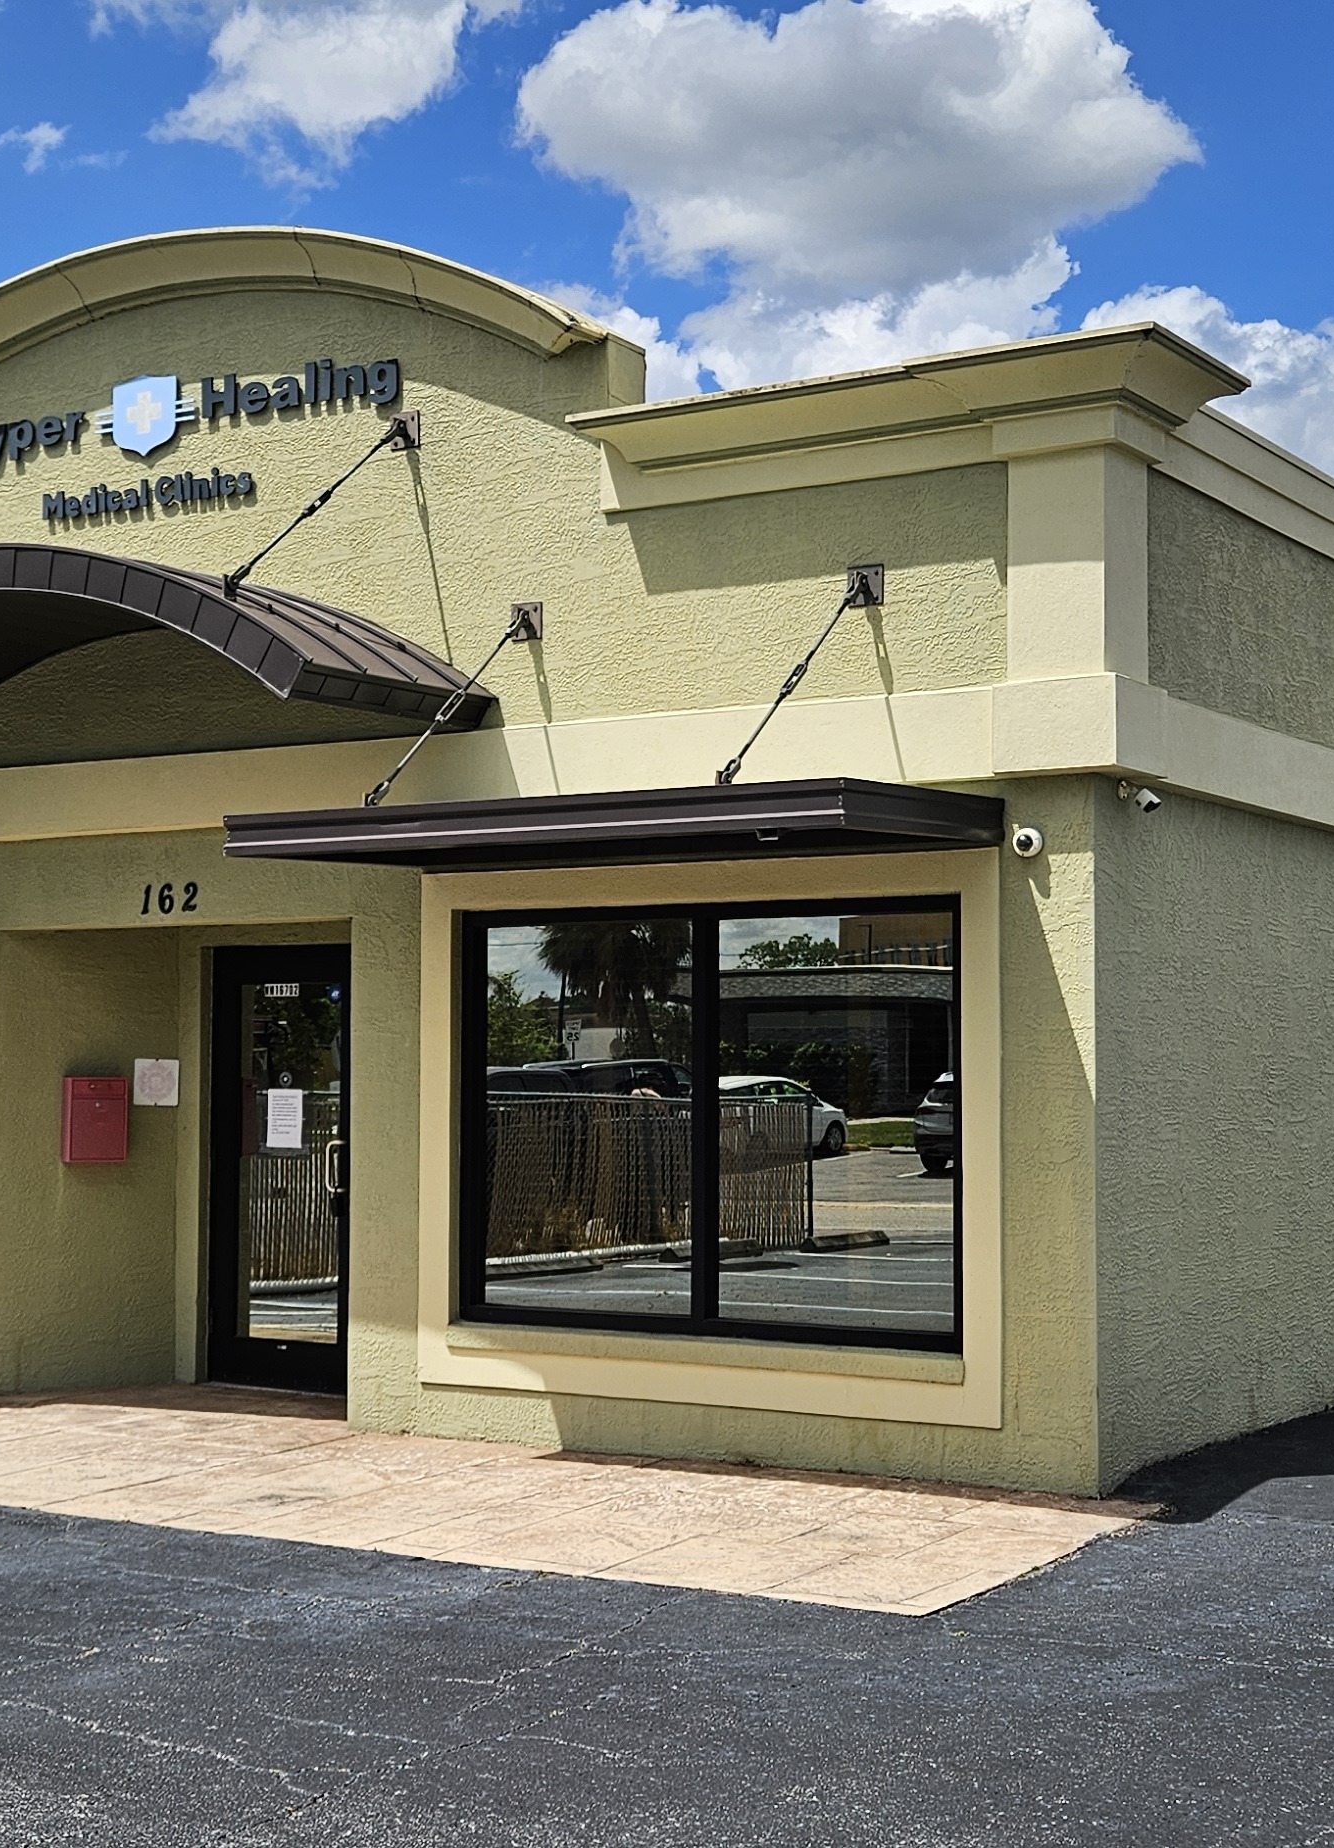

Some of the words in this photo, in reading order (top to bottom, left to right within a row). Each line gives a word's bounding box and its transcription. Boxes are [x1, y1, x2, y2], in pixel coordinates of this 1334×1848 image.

[201, 358, 399, 419] Healing
[42, 478, 149, 520] Medical
[155, 467, 253, 507] Clinics
[141, 882, 198, 915] 162
